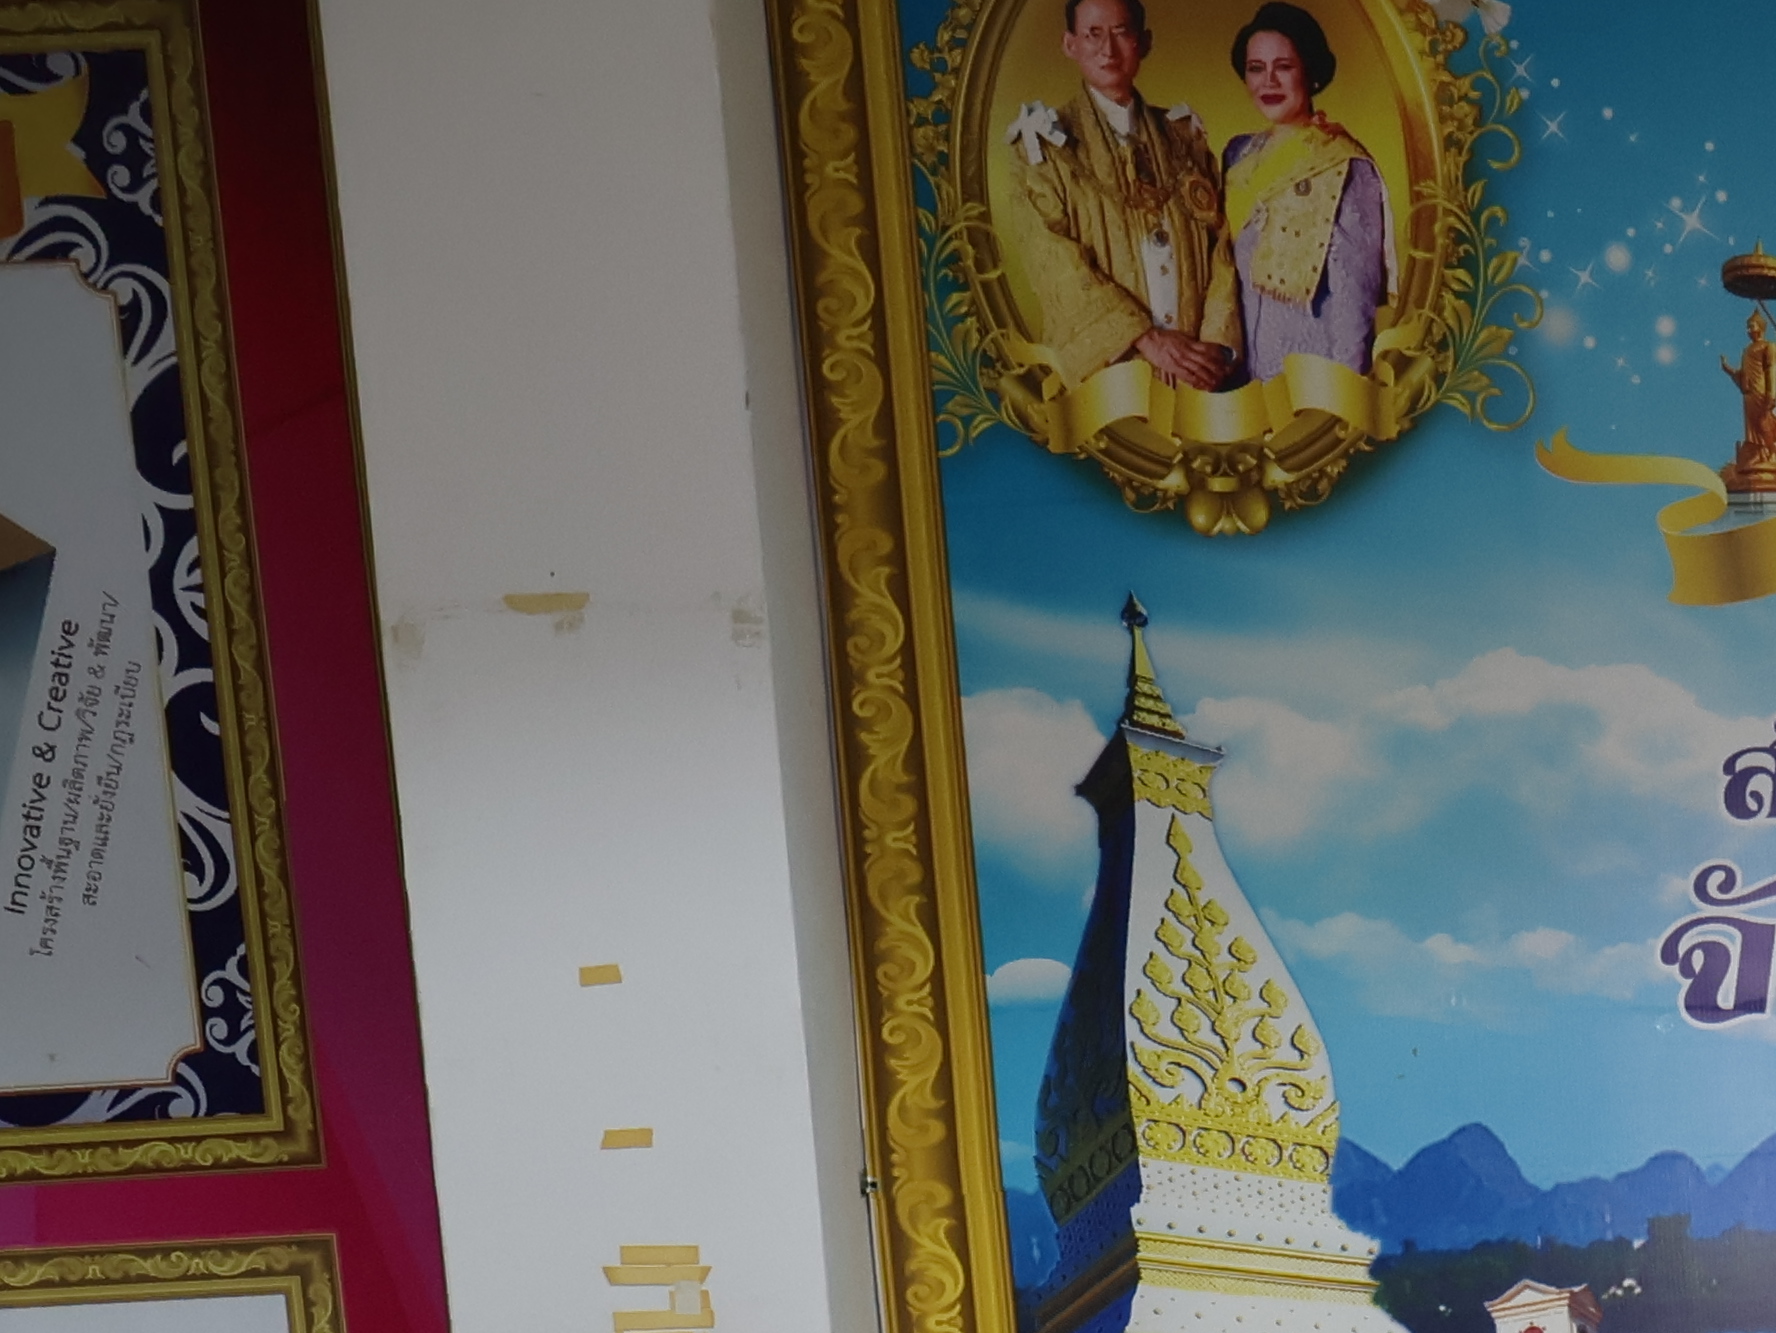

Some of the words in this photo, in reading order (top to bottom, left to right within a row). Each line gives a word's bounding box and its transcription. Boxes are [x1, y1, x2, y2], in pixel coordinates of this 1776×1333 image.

[38, 619, 79, 732] Creative
[32, 742, 57, 762] &
[4, 771, 51, 915] Innovative
